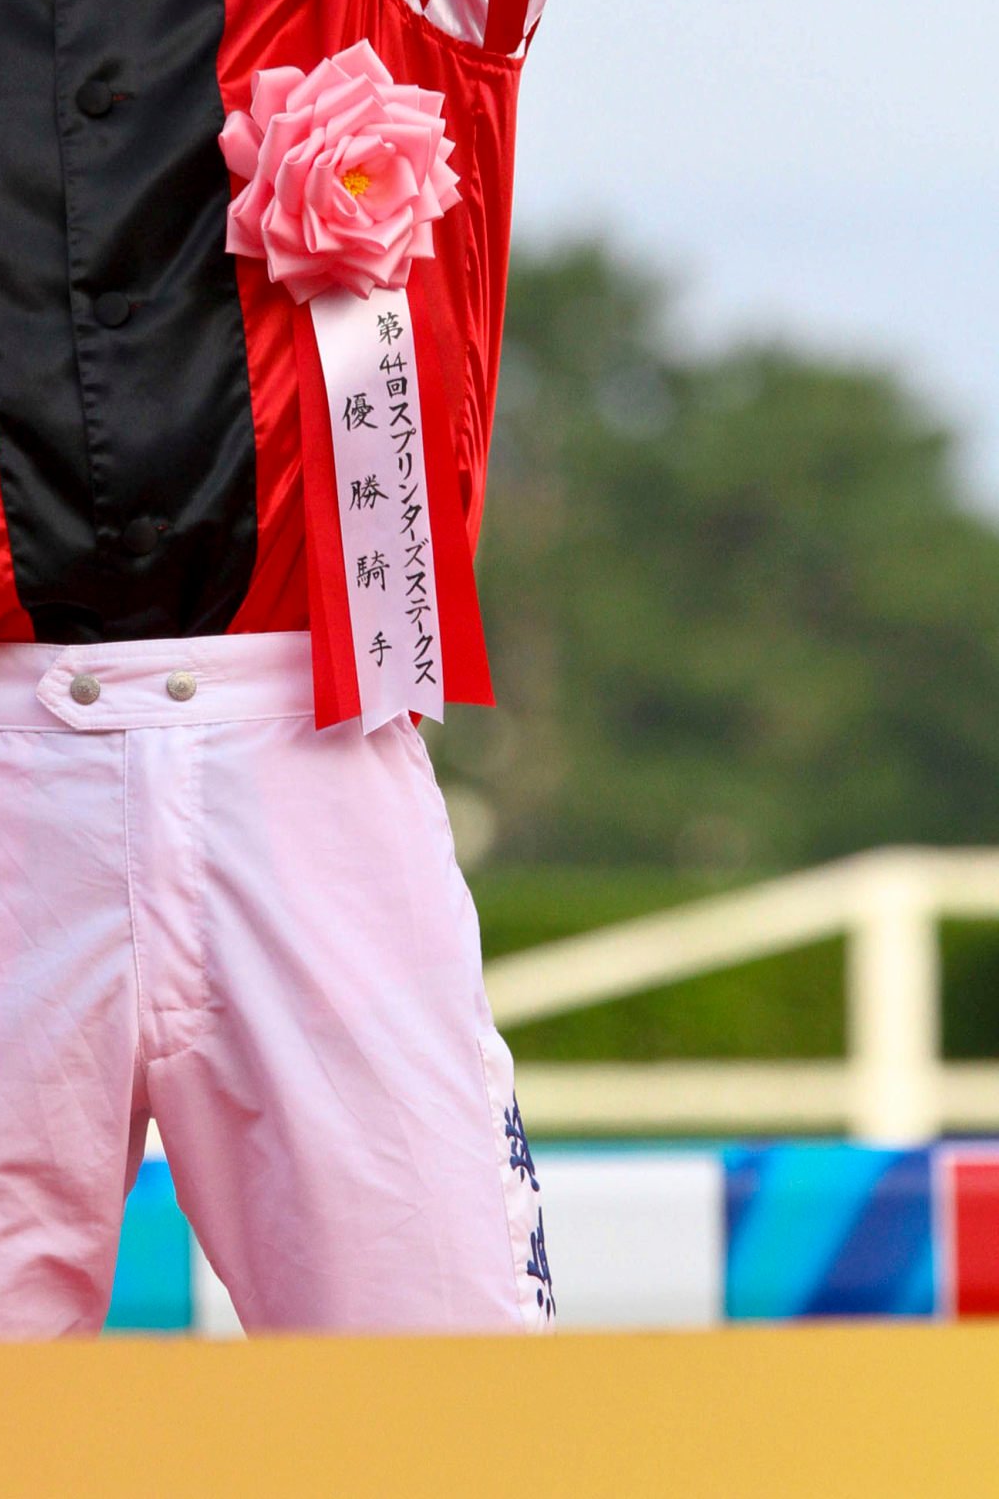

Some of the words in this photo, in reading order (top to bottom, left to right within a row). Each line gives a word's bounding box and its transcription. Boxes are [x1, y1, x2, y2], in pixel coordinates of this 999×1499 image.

[341, 393, 393, 668] 優勝騎手
[377, 311, 437, 685] 第44回スプリンターズステークス
